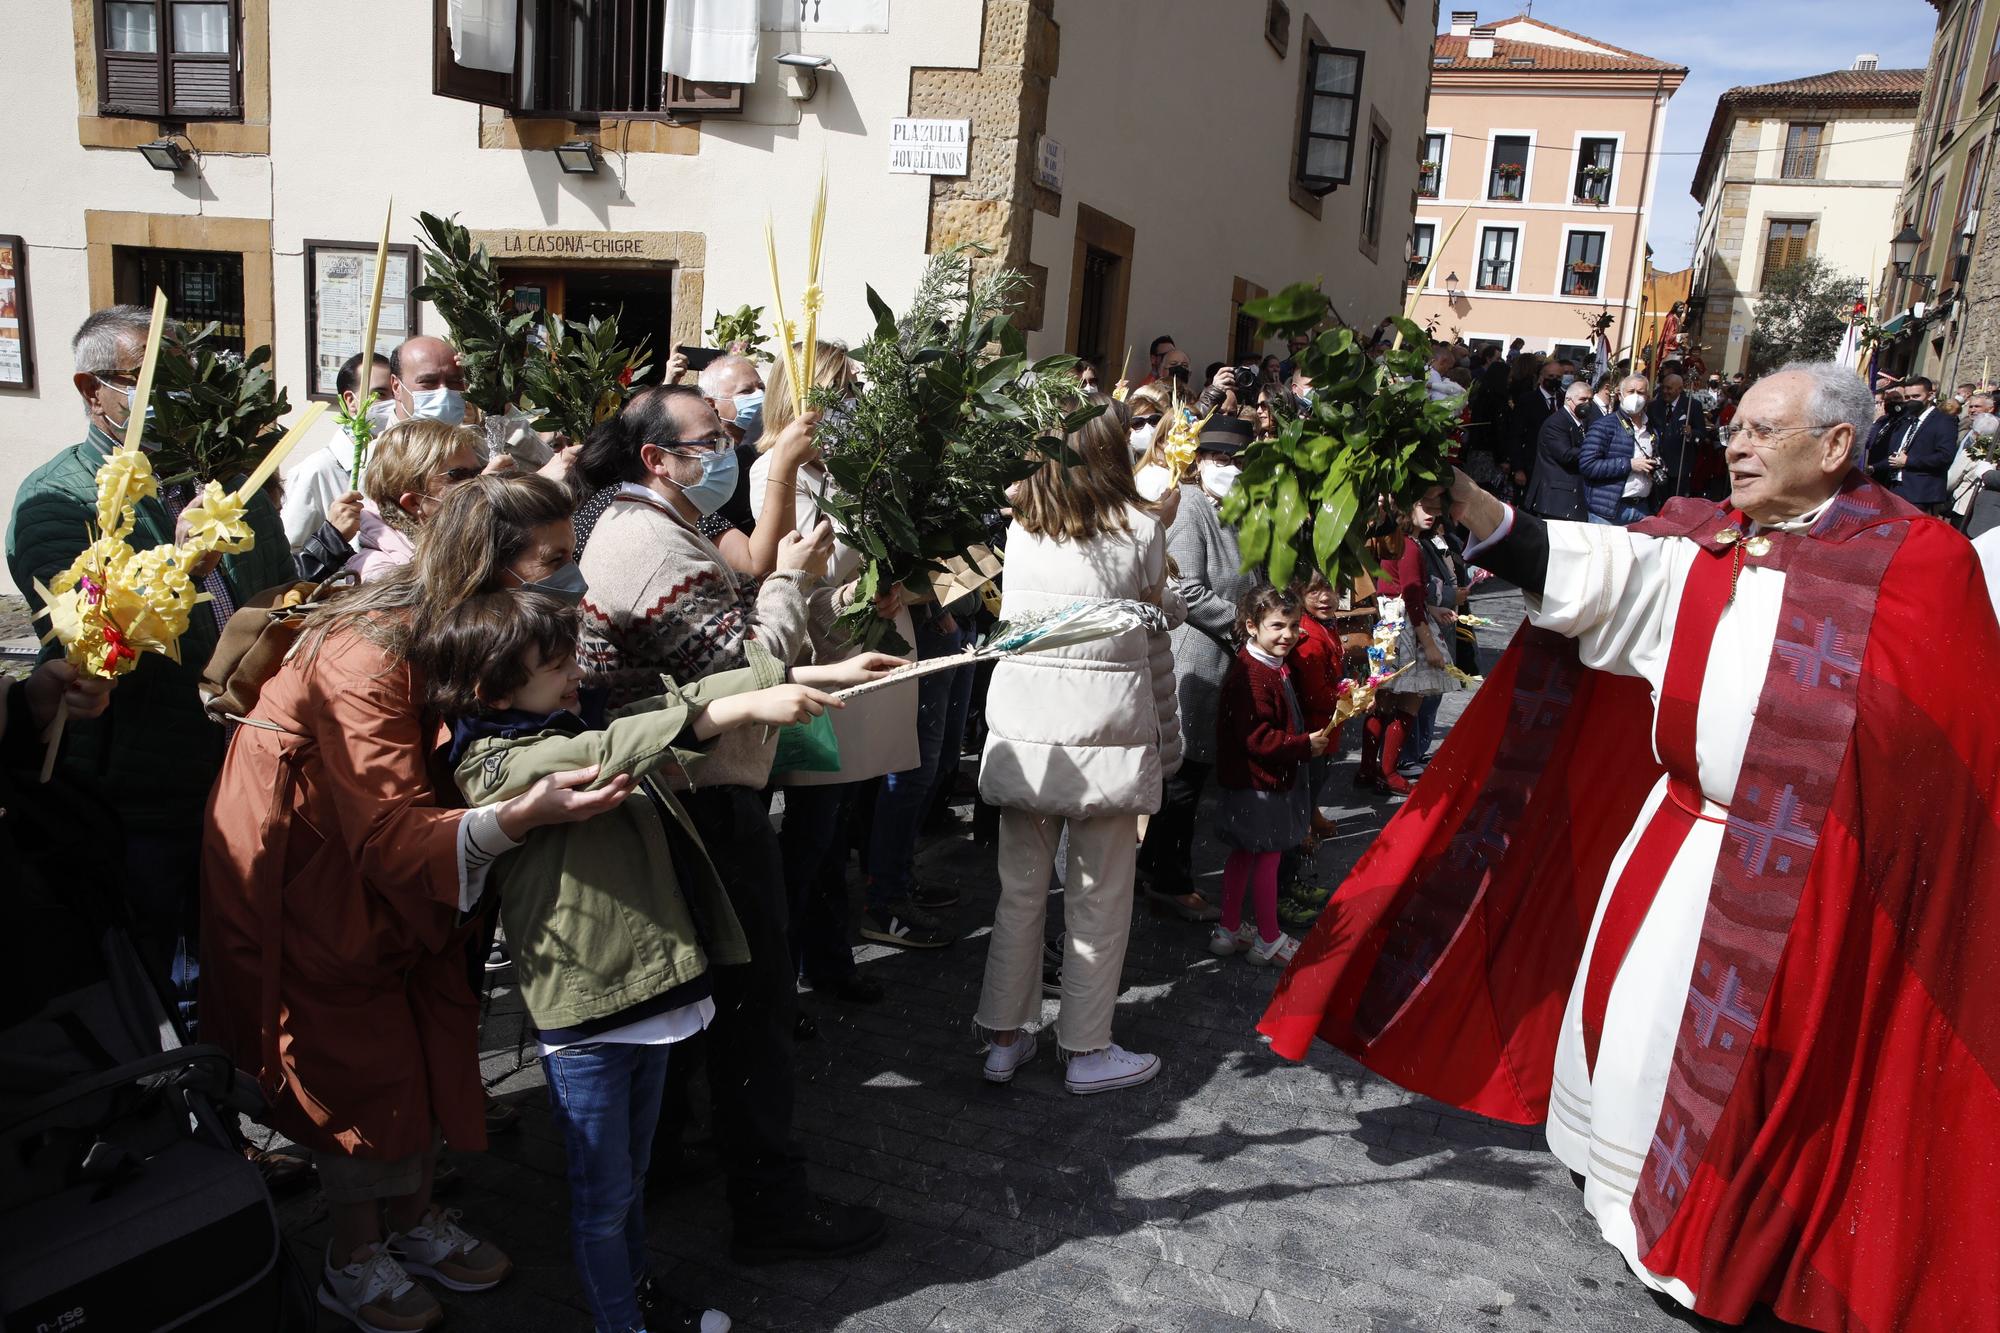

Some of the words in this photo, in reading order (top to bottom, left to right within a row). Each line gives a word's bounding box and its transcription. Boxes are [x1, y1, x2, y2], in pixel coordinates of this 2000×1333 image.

[893, 123, 965, 143] PLAZUELA
[922, 142, 935, 151] de
[892, 150, 963, 170] JOVELLANOS
[504, 235, 522, 252] LA
